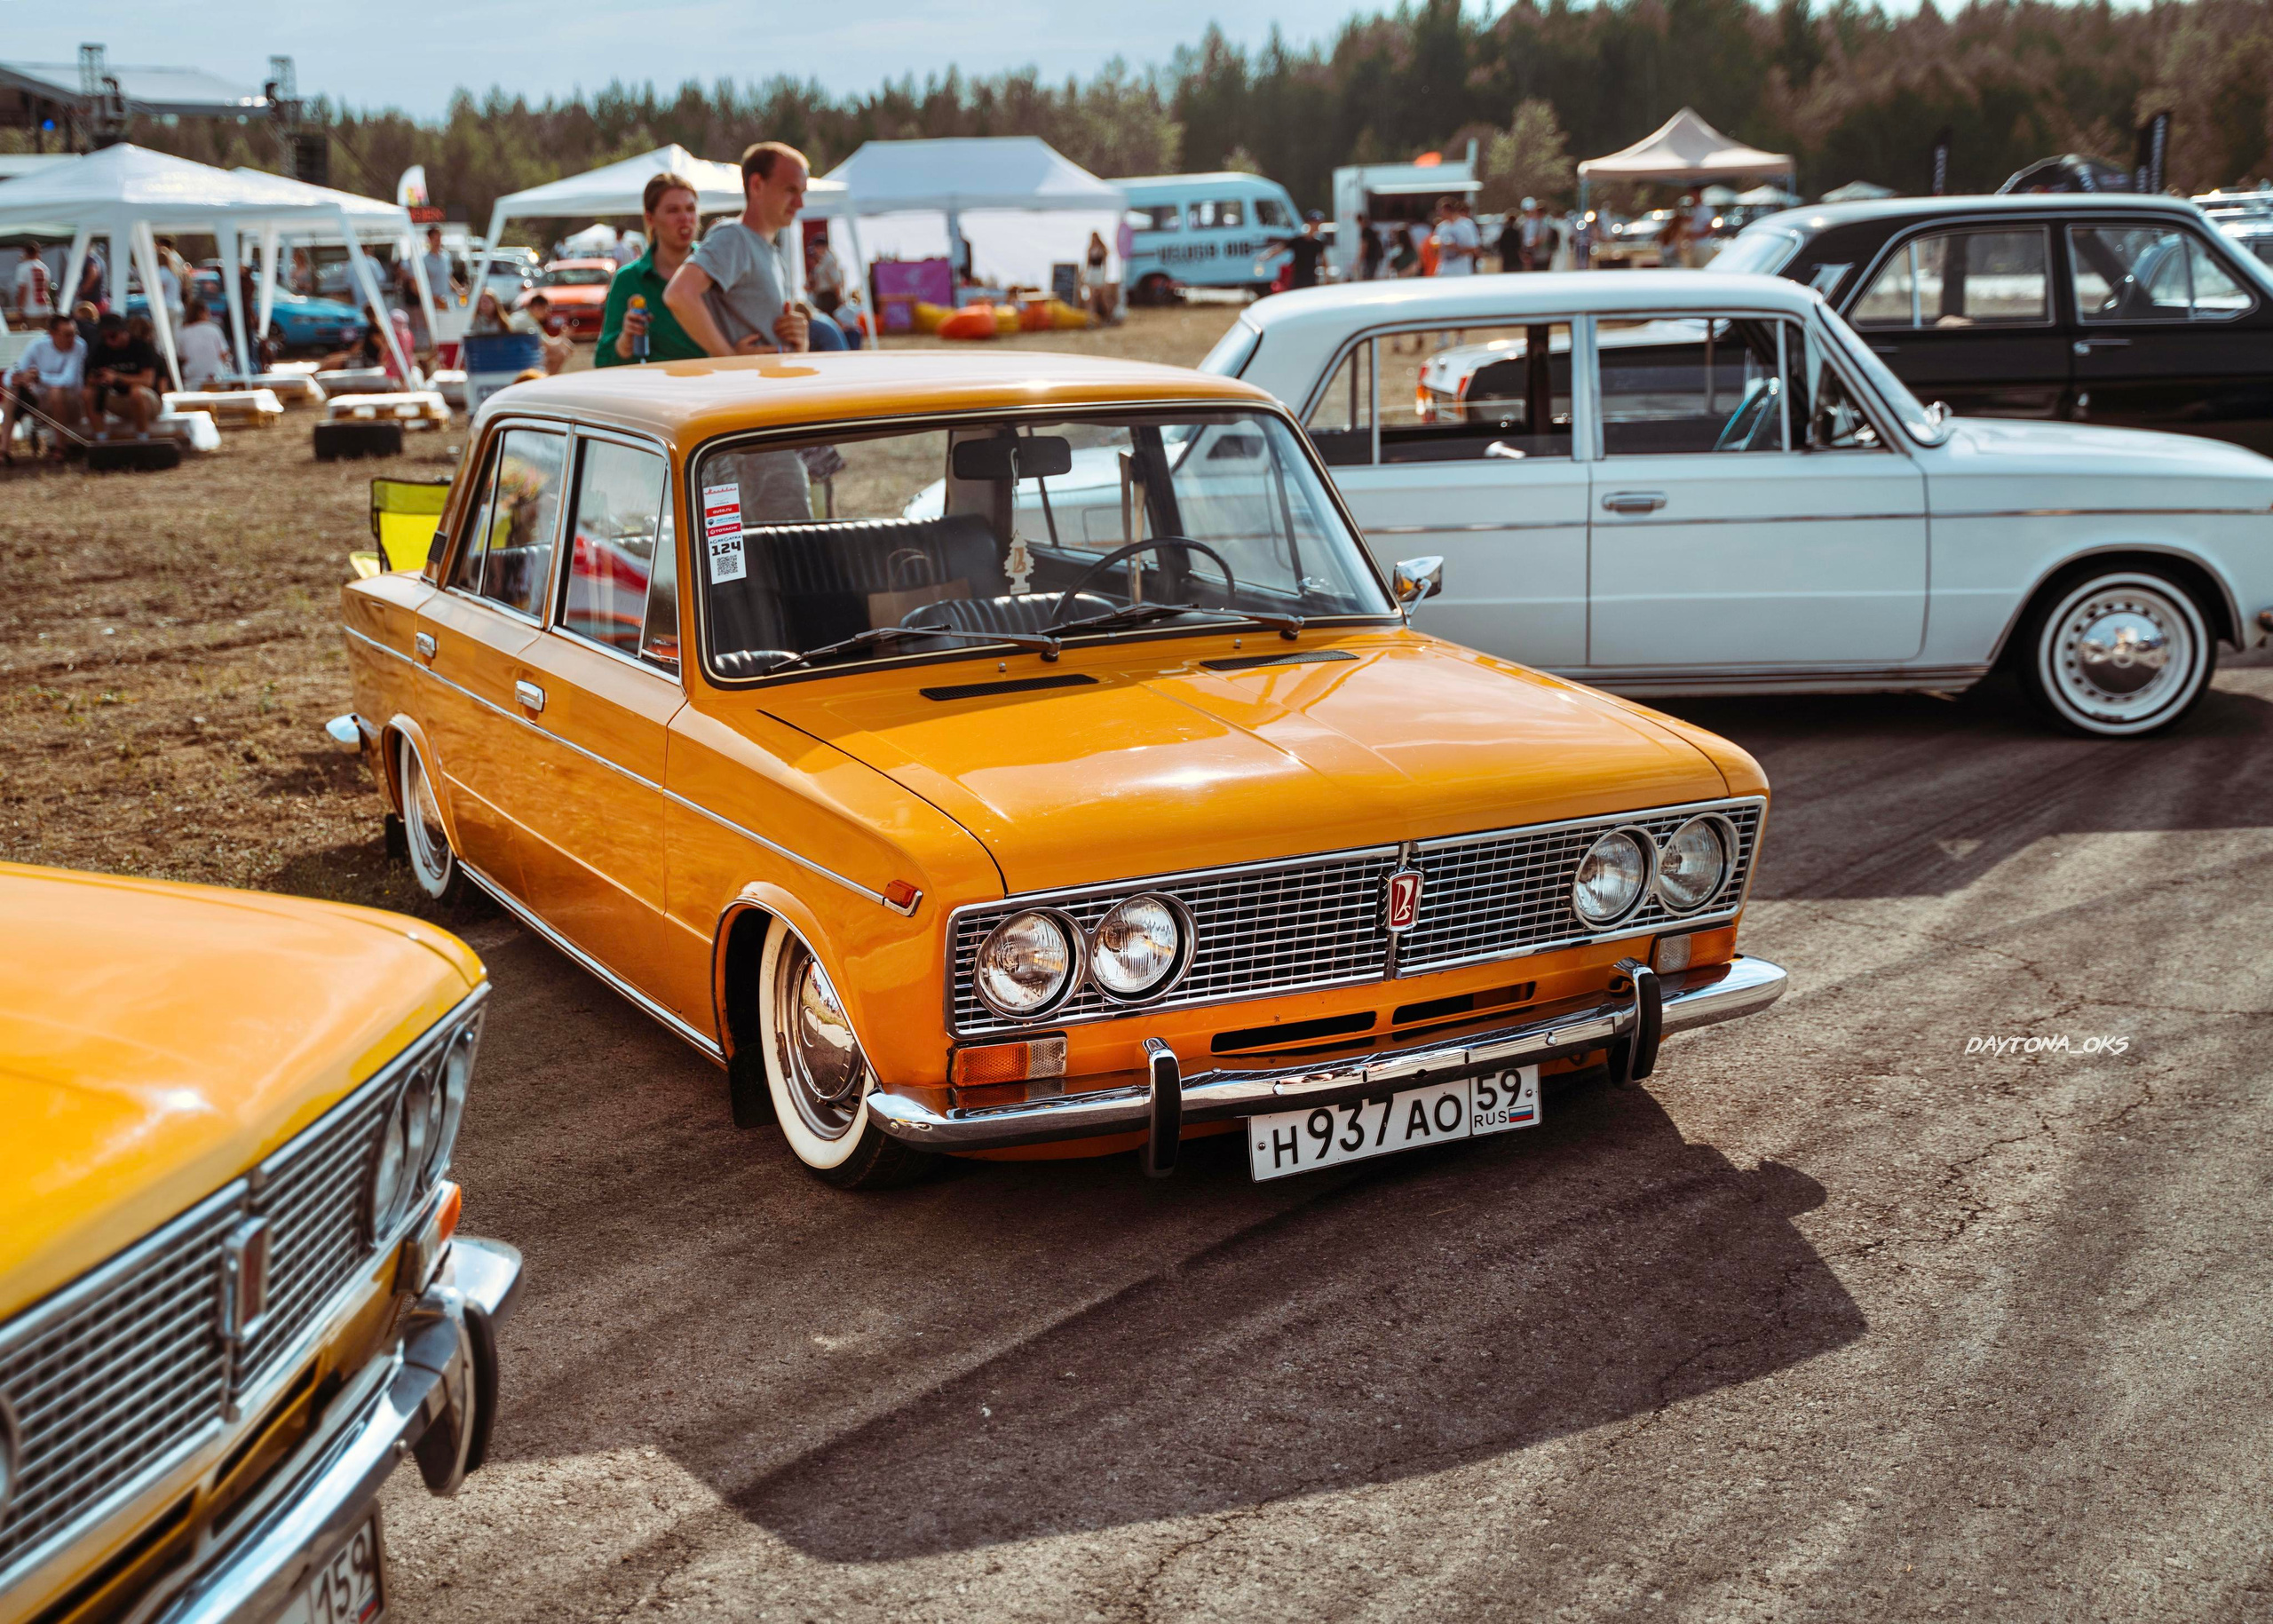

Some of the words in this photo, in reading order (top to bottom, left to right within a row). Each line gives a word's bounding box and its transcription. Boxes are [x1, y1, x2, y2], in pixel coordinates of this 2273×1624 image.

[711, 541, 741, 556] 124
[1477, 1069, 1522, 1111] 59
[1474, 1110, 1507, 1128] RUS
[317, 1532, 373, 1624] 159
